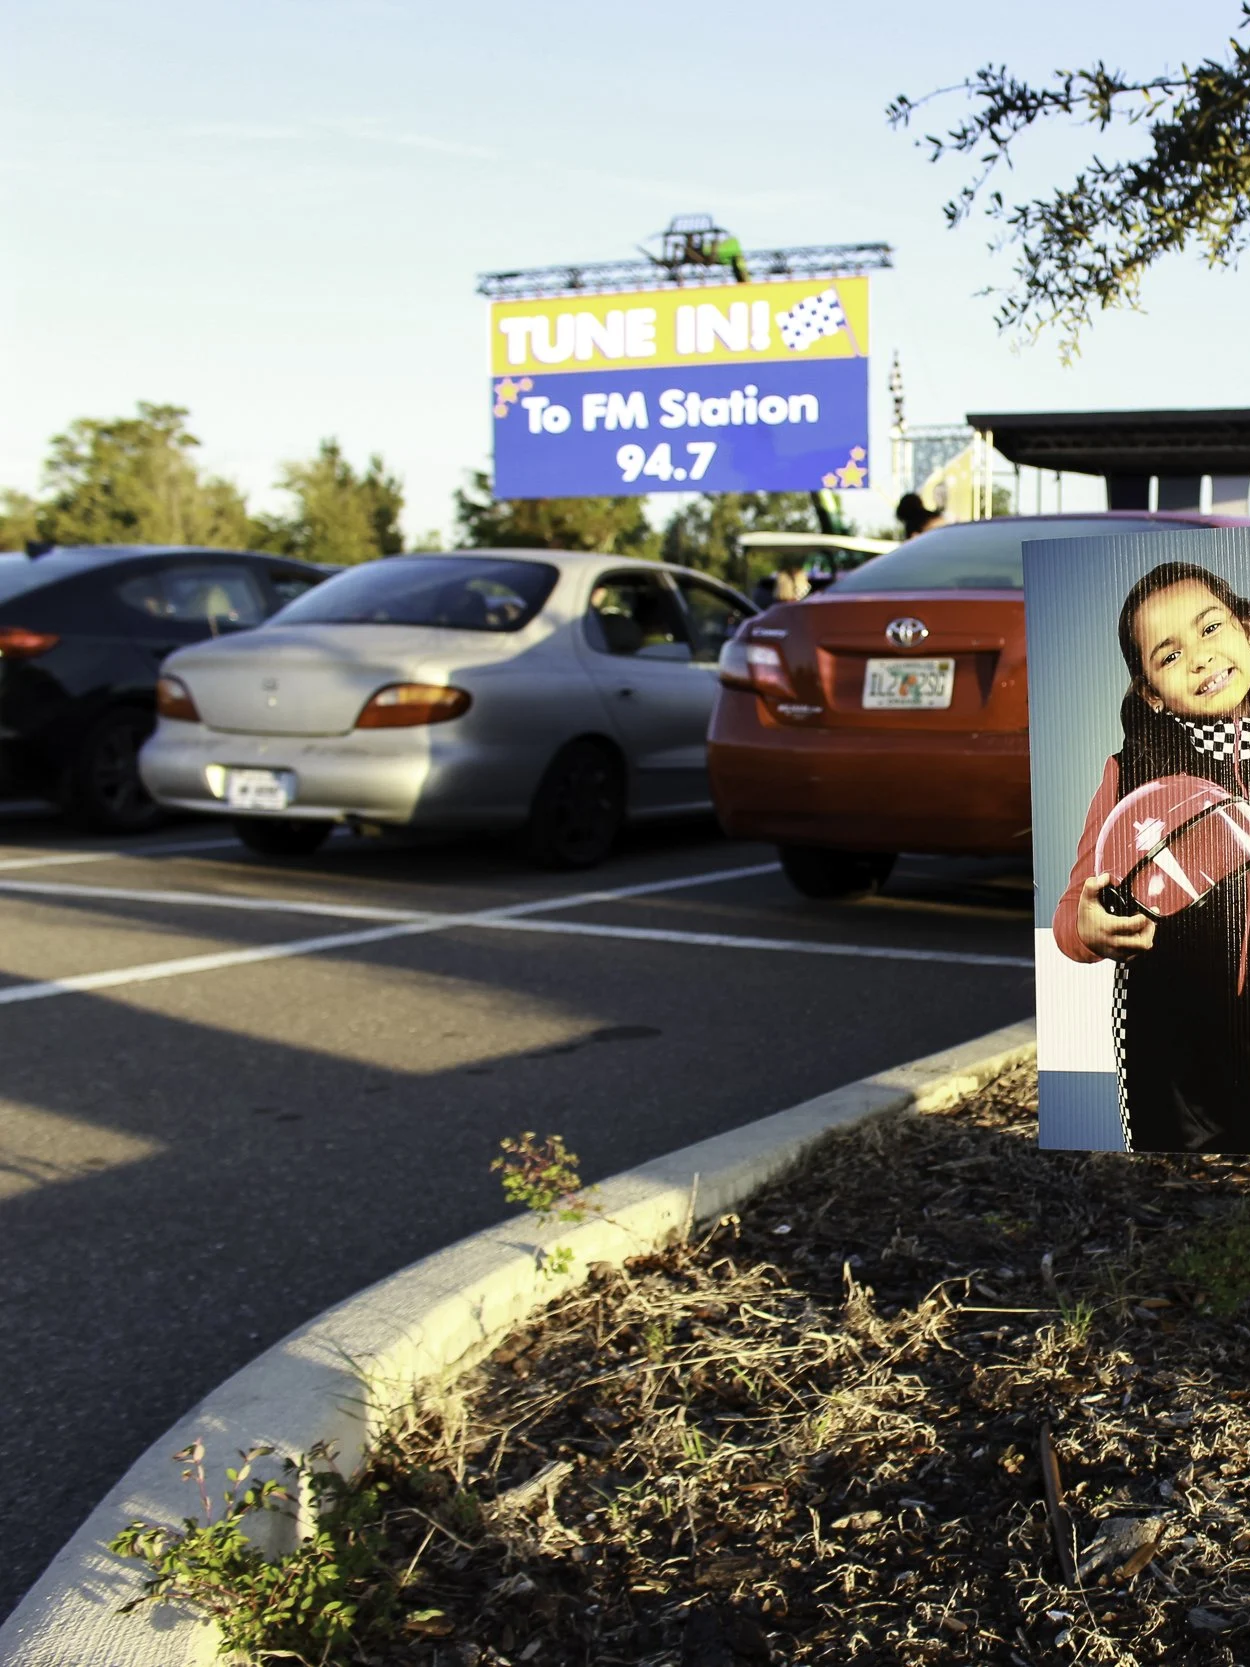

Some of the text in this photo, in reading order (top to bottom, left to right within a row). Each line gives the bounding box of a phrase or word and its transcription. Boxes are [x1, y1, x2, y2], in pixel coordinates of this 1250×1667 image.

[499, 300, 770, 365] TUNE IN!
[521, 384, 819, 434] To FM Station
[616, 441, 717, 483] 94.7
